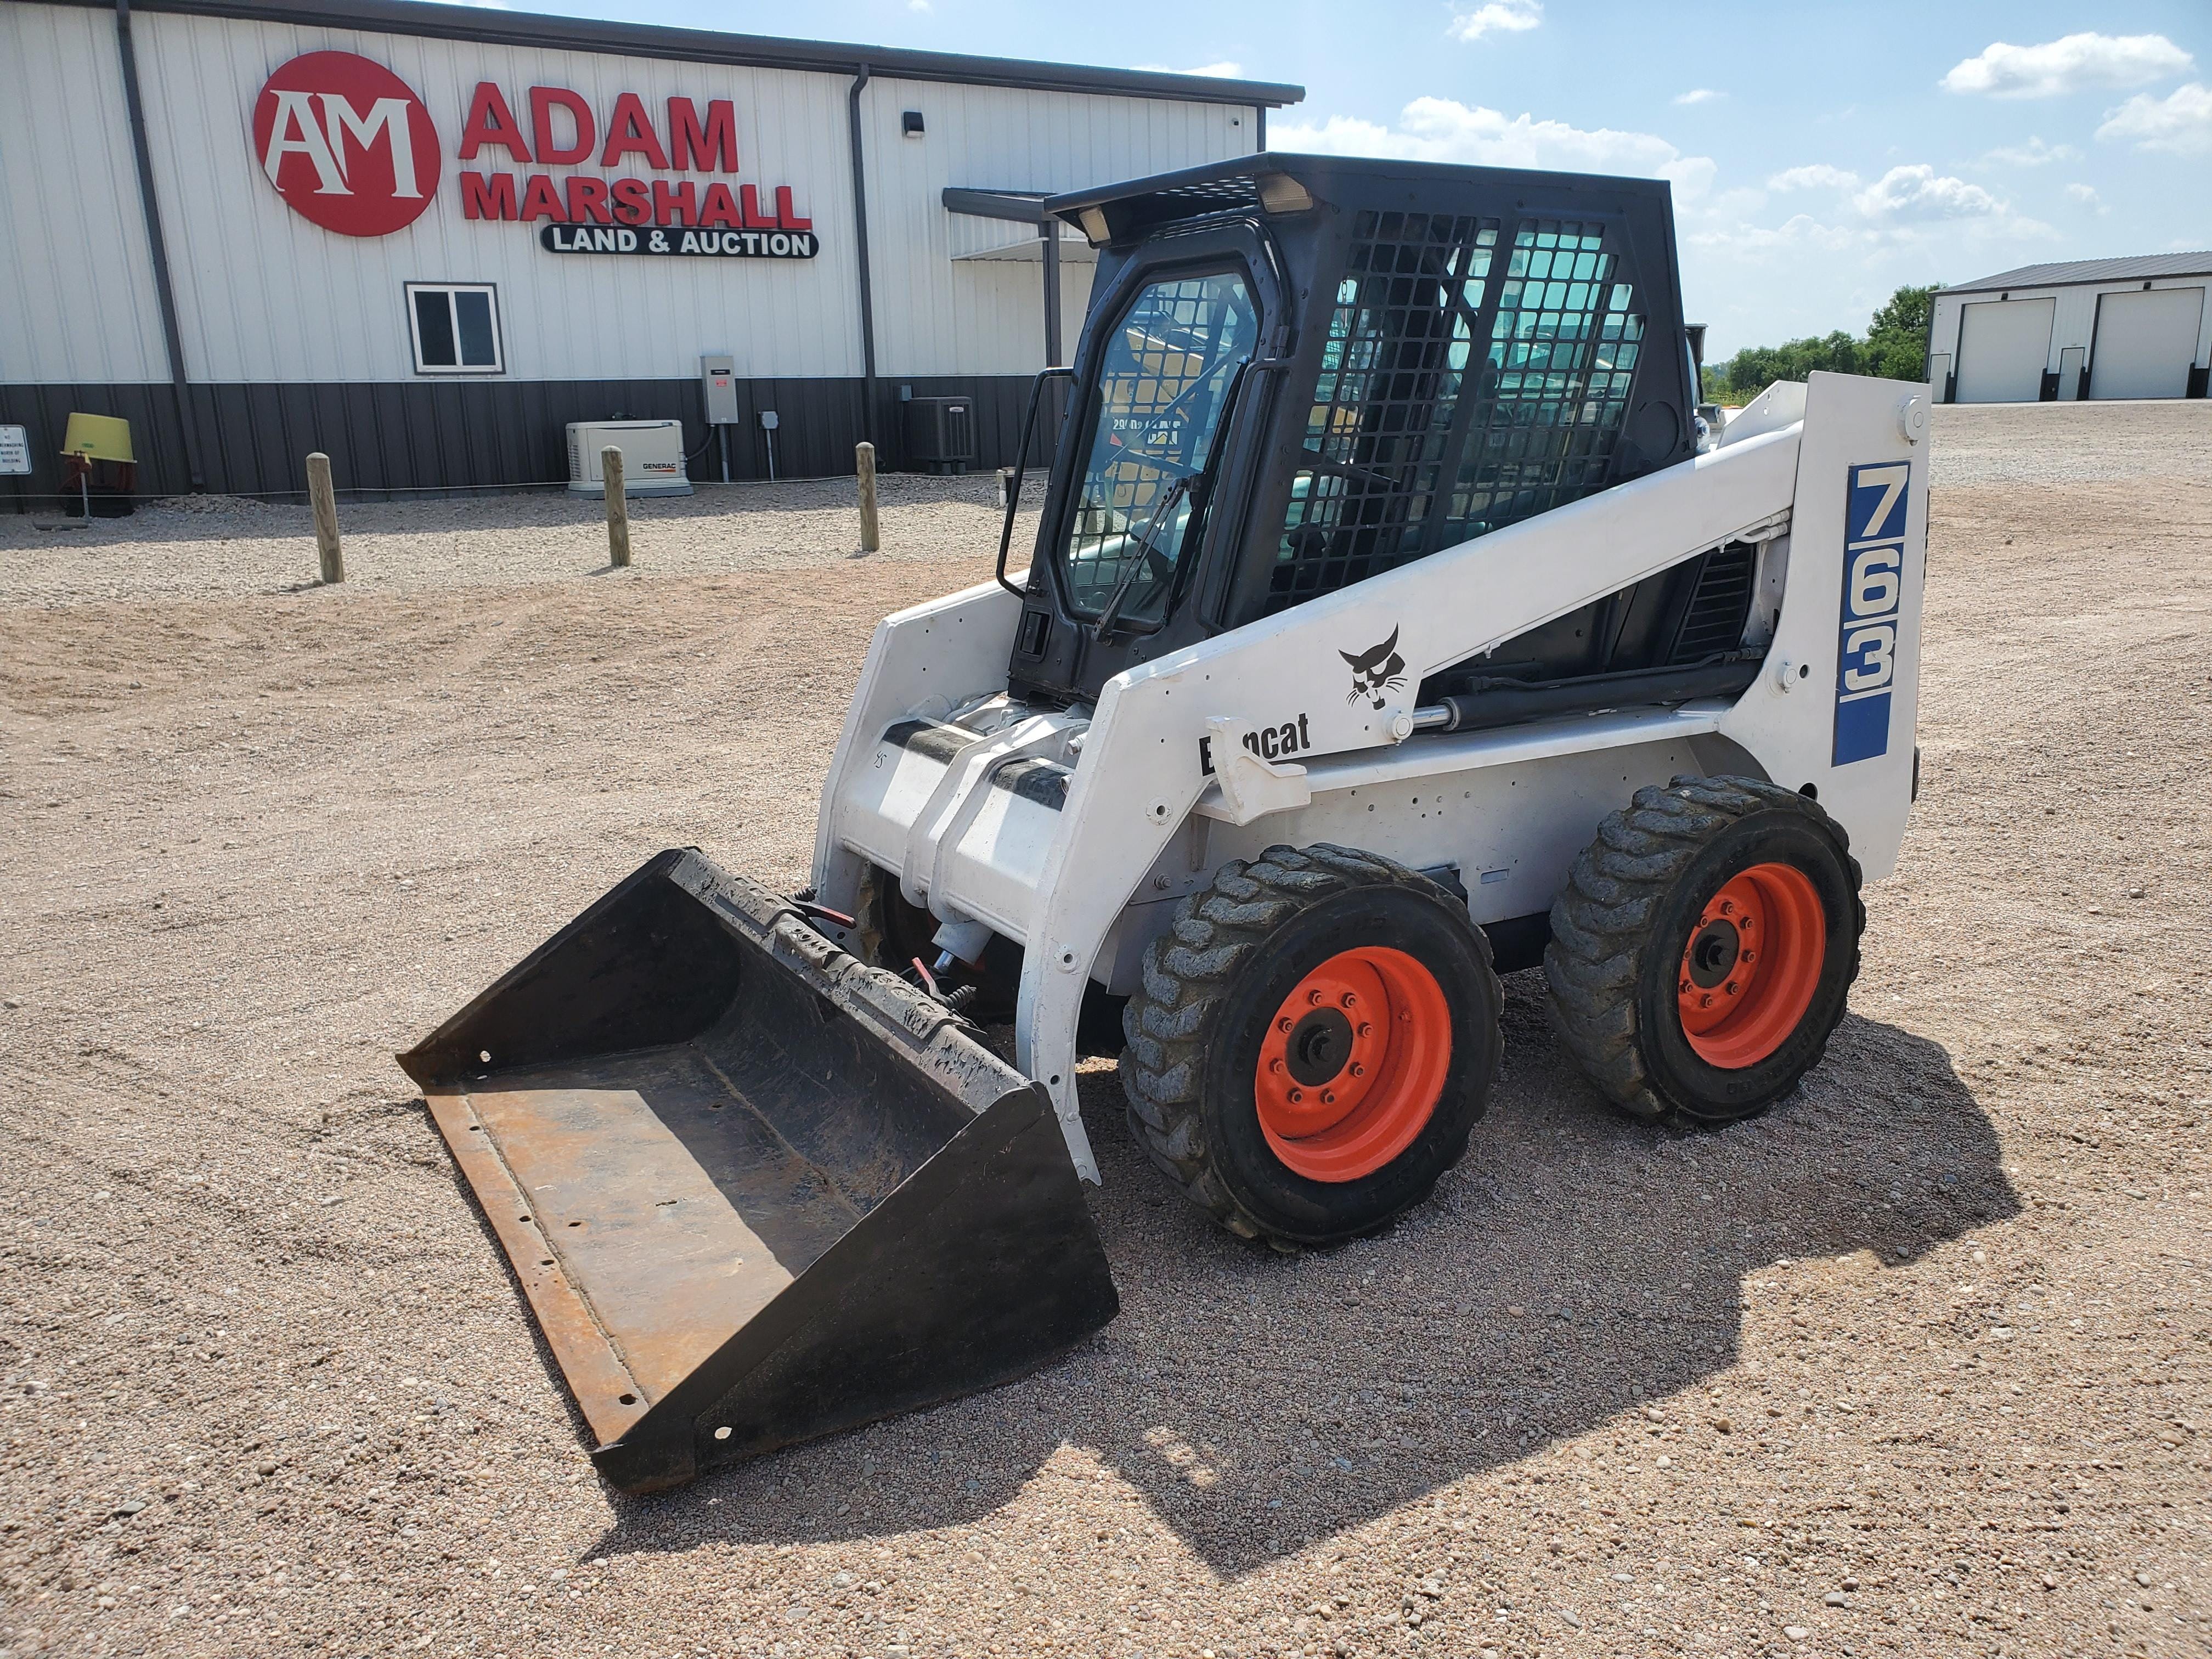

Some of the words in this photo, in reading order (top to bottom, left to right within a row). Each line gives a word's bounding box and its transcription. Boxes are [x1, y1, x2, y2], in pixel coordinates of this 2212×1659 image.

[264, 89, 424, 198] AM
[458, 81, 739, 173] ADAM
[459, 171, 812, 230] MARSHALL
[553, 228, 637, 251] LAND
[648, 230, 670, 252] &
[680, 232, 810, 256] AUCTION
[1844, 465, 1909, 691] 763
[1199, 713, 1310, 777] Bcat
